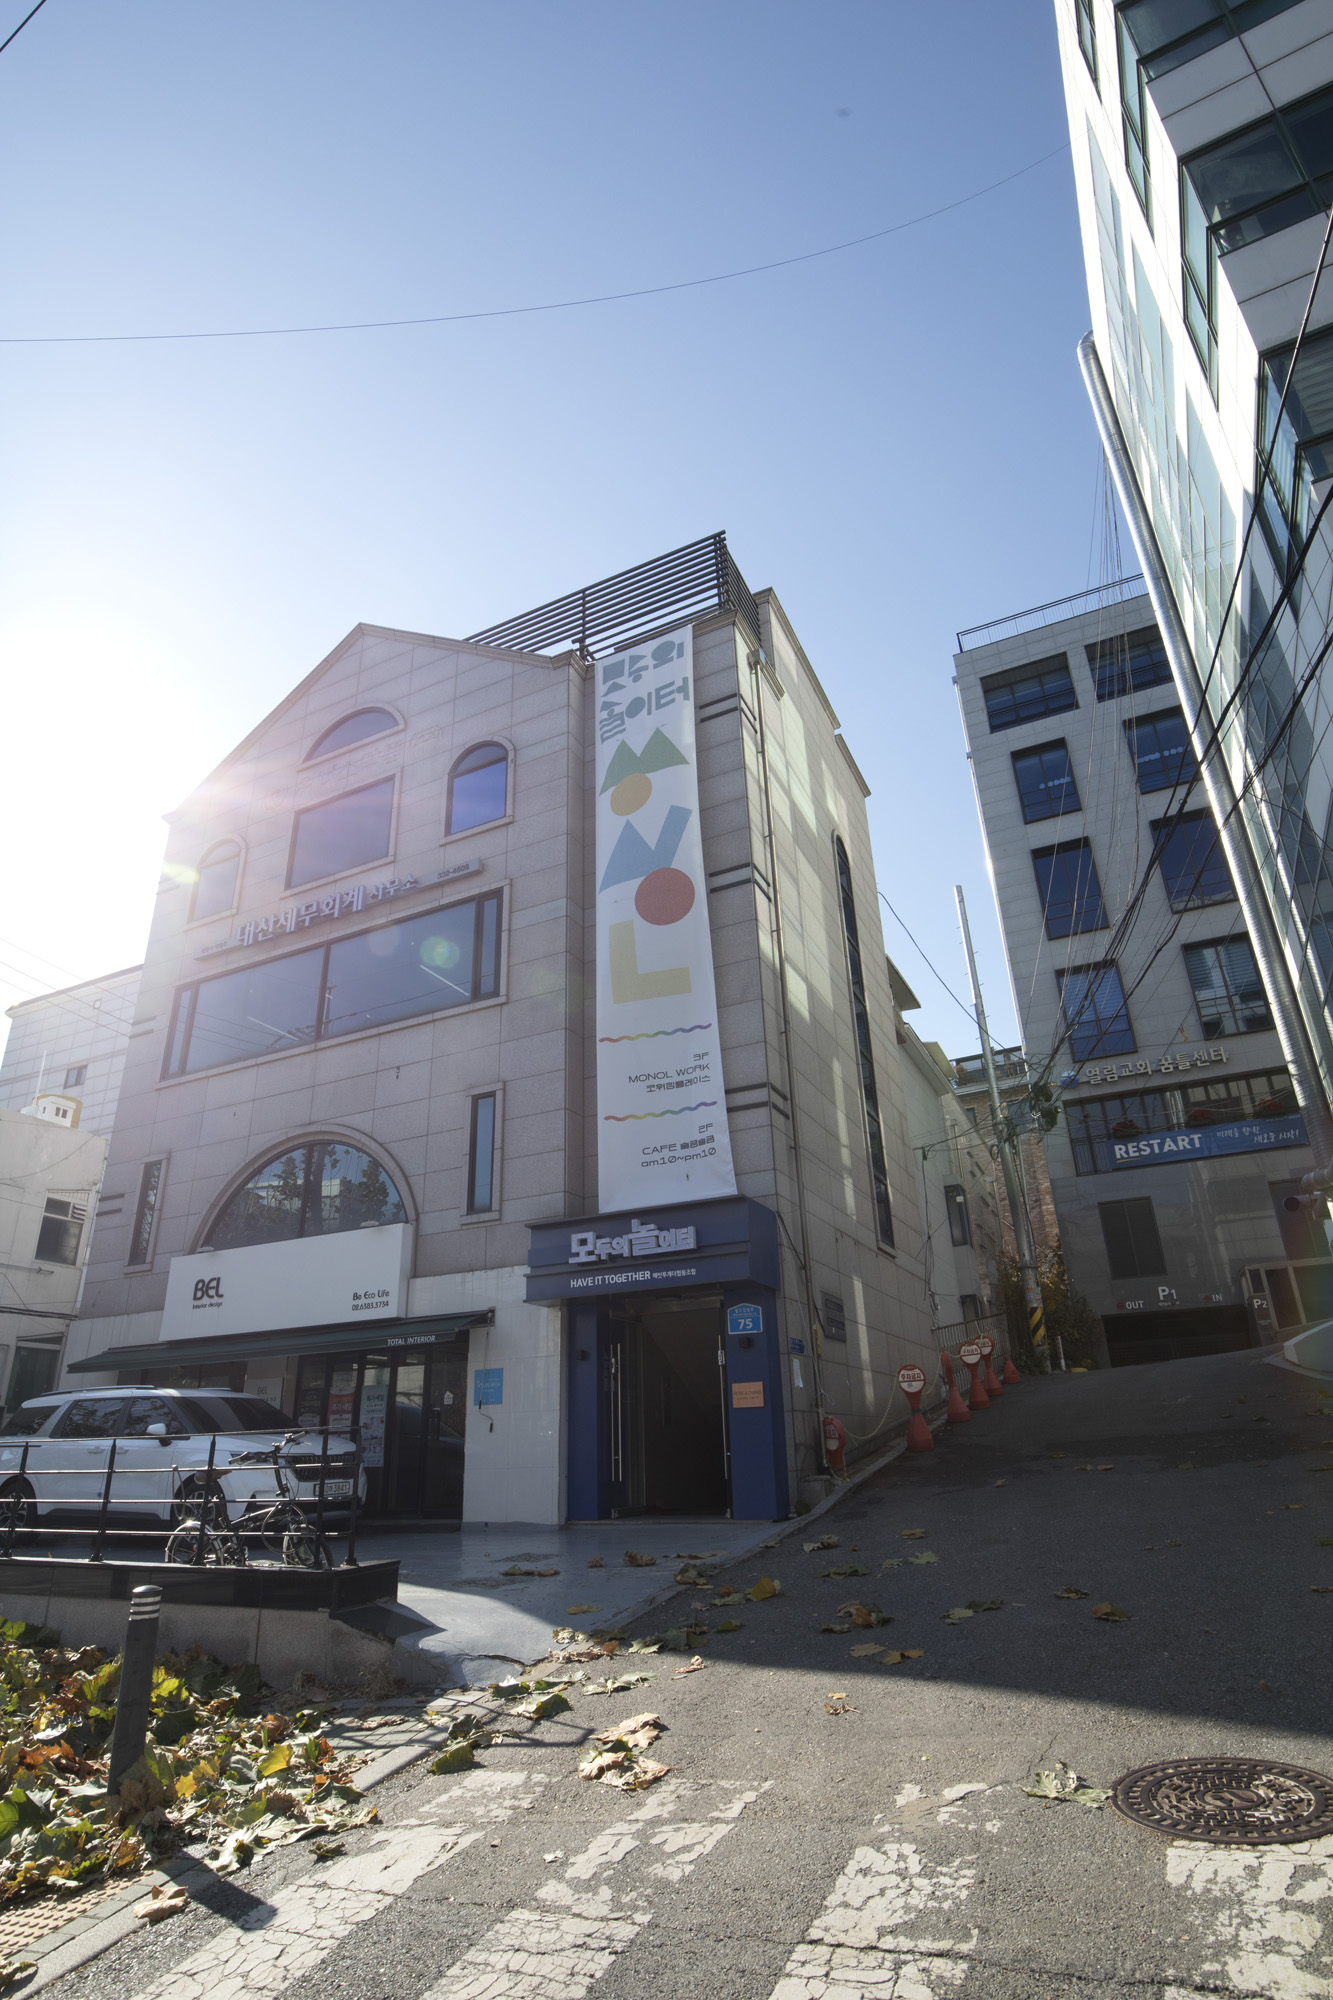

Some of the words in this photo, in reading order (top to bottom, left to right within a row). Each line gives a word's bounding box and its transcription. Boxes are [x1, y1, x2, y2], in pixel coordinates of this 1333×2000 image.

[436, 863, 471, 880] 332-4509
[236, 884, 369, 947] 대산세무회계
[369, 873, 421, 900] 사무소
[693, 1052, 710, 1061] 3F
[628, 1070, 673, 1084] MONOL
[675, 1062, 711, 1077] WORK
[1085, 1059, 1153, 1086] 열림교회
[1158, 1046, 1230, 1074] 꿈틀센터
[698, 1123, 714, 1134] 2F
[642, 1143, 678, 1156] CAFE
[1114, 1133, 1204, 1161] RESTART
[641, 1146, 717, 1168] am10~pm10
[570, 1276, 594, 1288] HAVE
[594, 1275, 603, 1286] IT
[605, 1270, 651, 1284] TOGETHER
[192, 1276, 224, 1301] BEL
[352, 1291, 363, 1301] Be
[363, 1290, 376, 1300] Eco
[377, 1289, 390, 1298] Life
[1157, 1286, 1177, 1301] P1
[1125, 1300, 1145, 1310] OUT
[1211, 1293, 1224, 1303] IN
[1253, 1298, 1269, 1309] P2
[737, 1318, 753, 1330] 75
[387, 1337, 405, 1347] TOTAL
[406, 1334, 436, 1345] INTERIOR
